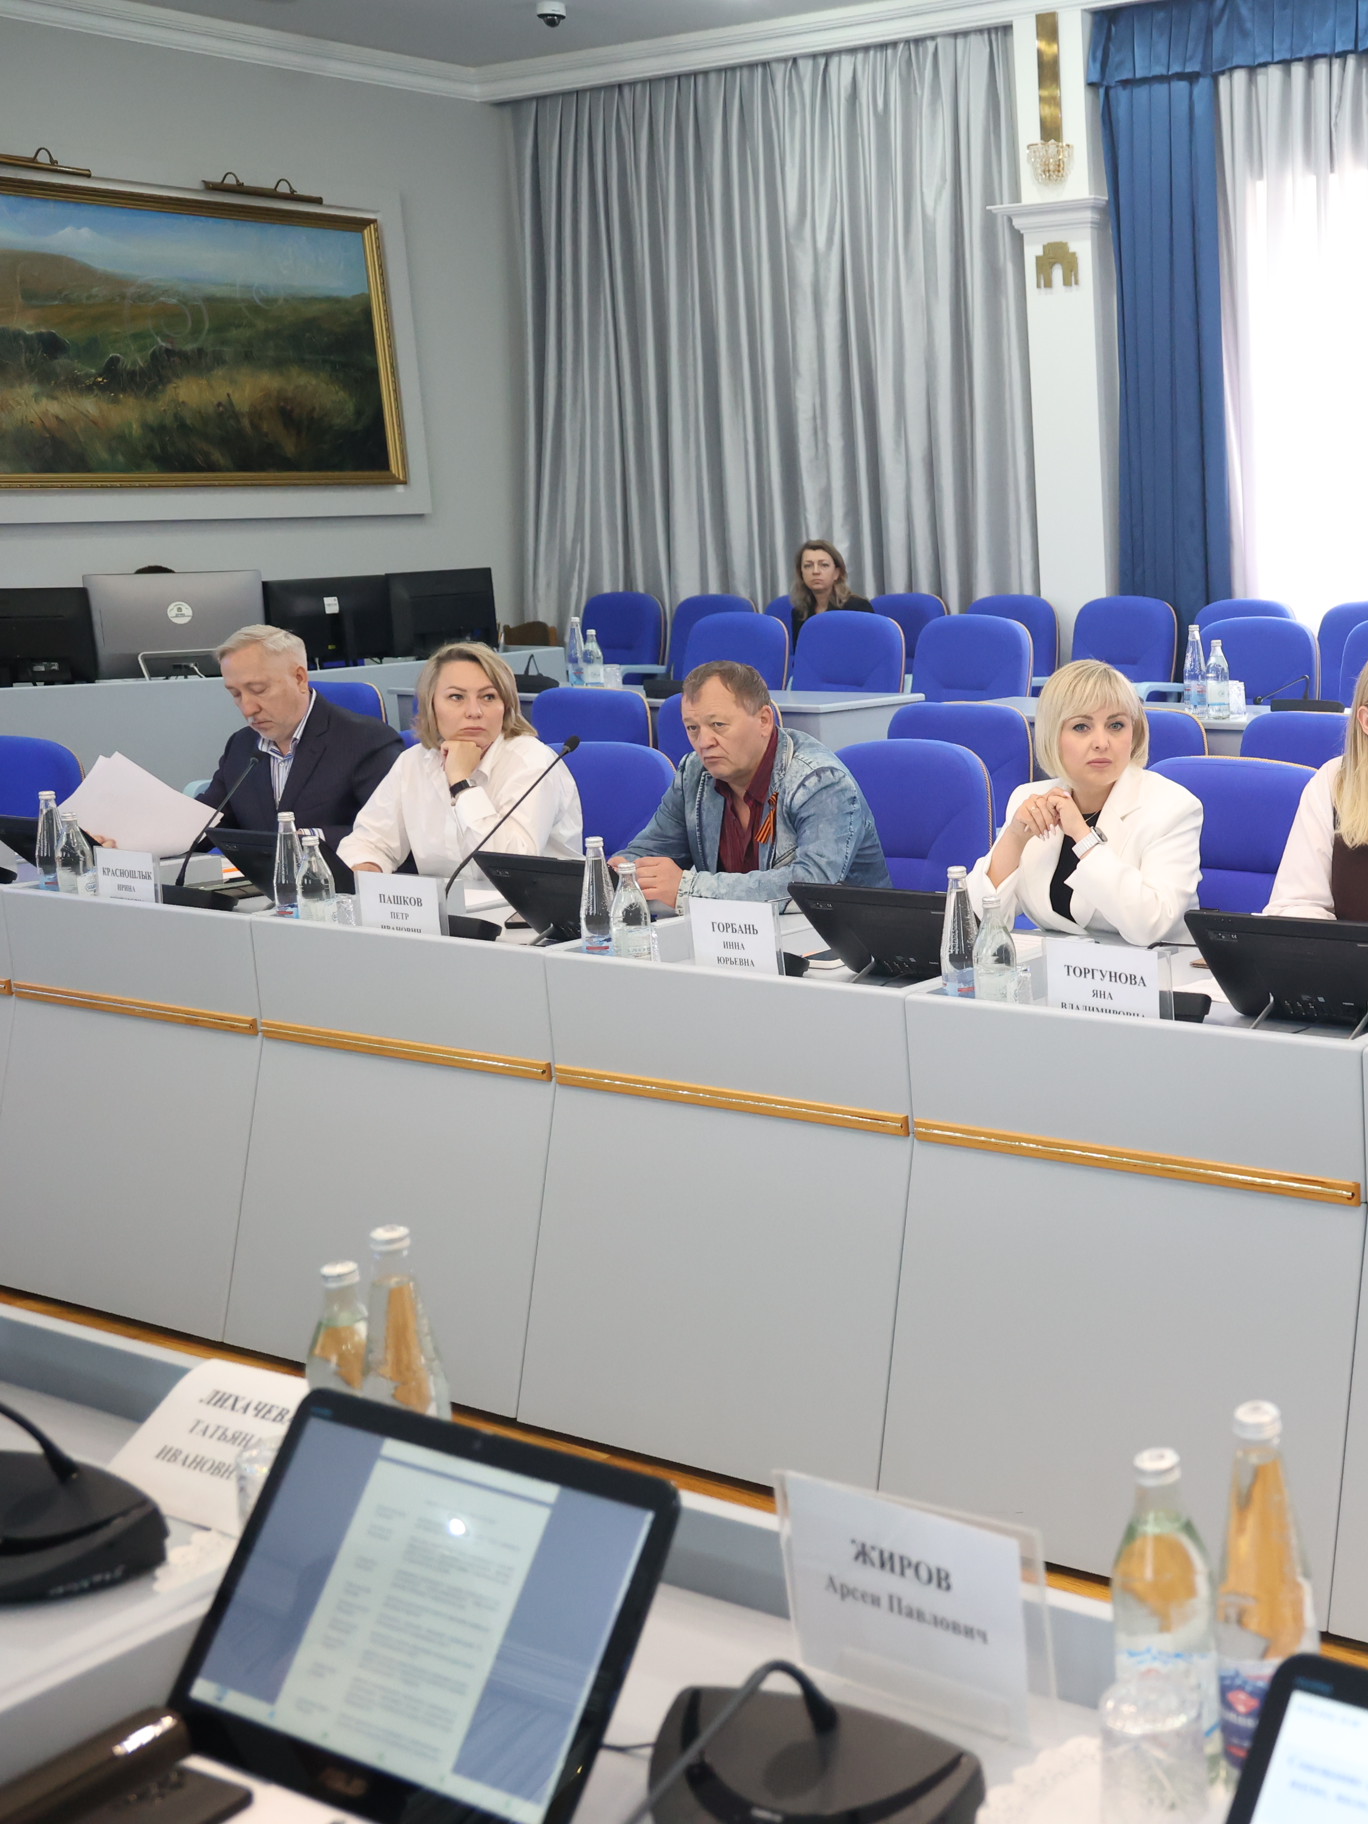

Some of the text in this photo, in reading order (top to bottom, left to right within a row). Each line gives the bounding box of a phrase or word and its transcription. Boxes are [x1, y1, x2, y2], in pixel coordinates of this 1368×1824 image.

[379, 894, 423, 907] ПАШКОВ
[390, 911, 410, 920] ПЕТР
[711, 921, 759, 935] ГОРБАНЬ
[723, 941, 745, 951] ИННА
[716, 956, 755, 967] ЮРЬЕВНА
[1064, 964, 1147, 987] ТОРГУНОВА
[1092, 989, 1113, 1000] ЯНА
[198, 1389, 294, 1425] ЛИХАЧЕВ
[188, 1419, 261, 1449] ТАТЬЯН
[154, 1444, 237, 1481] ИВАНОВН
[850, 1537, 953, 1593] ЖИРОВ
[825, 1574, 989, 1646] Арсен Павлович
